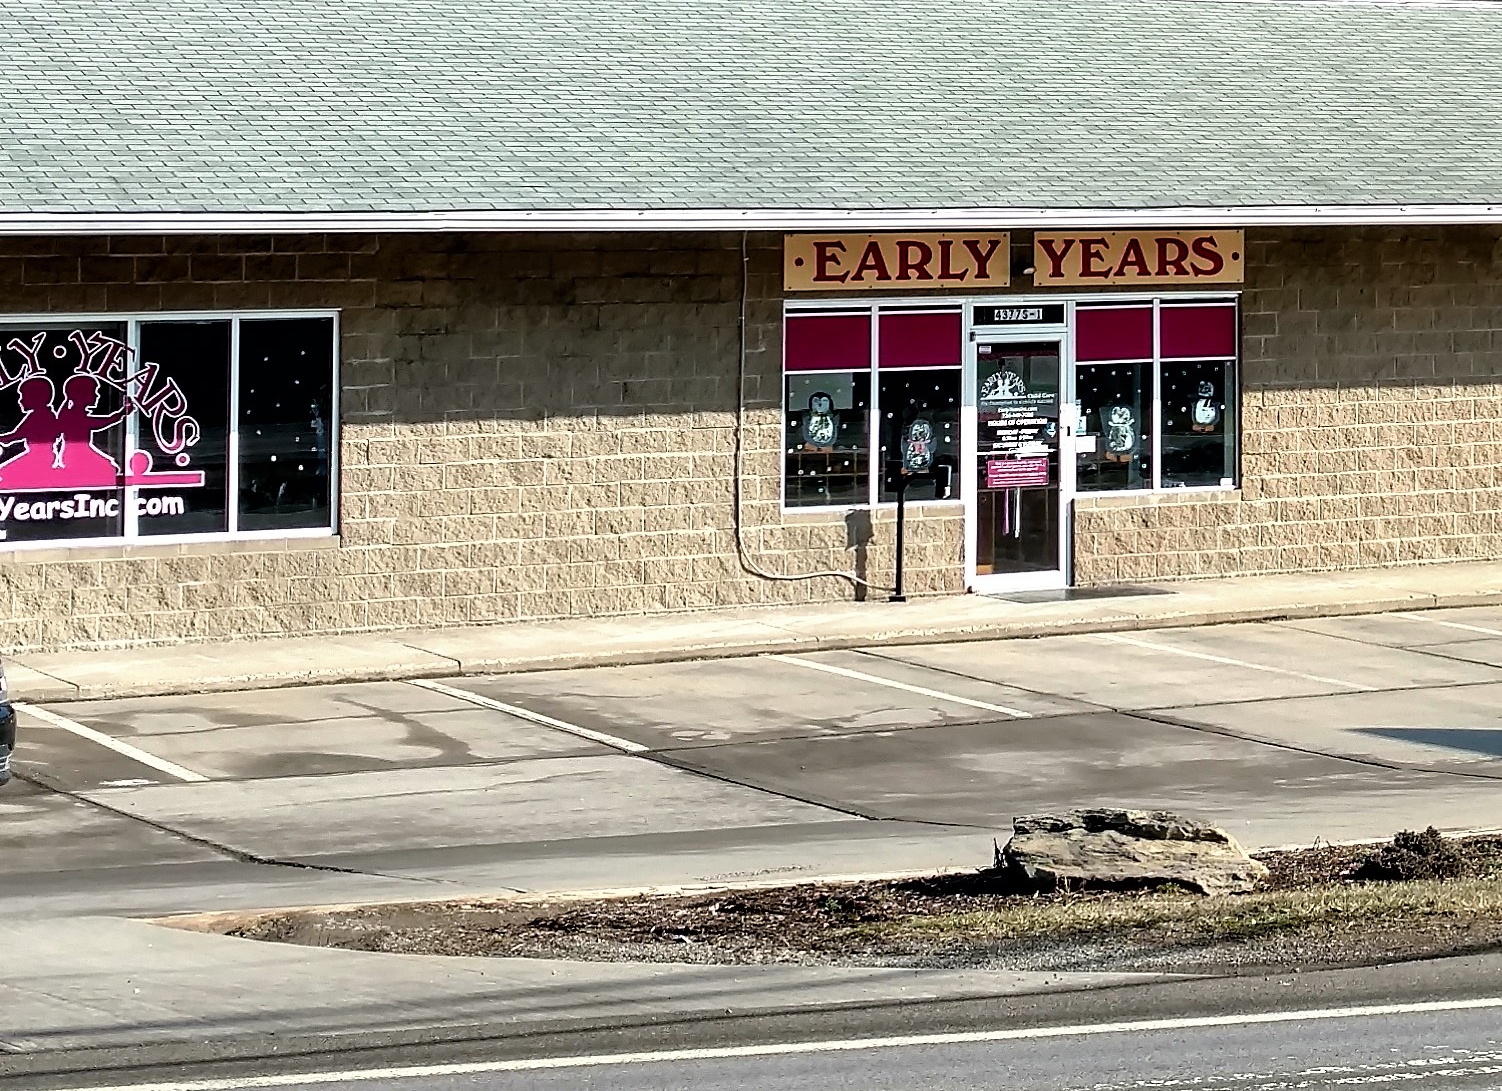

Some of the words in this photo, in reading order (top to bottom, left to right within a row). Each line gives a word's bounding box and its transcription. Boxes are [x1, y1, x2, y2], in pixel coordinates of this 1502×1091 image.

[812, 238, 1001, 284] EARLY
[1037, 235, 1225, 279] YEARS
[994, 309, 1041, 320] 43775-1
[68, 329, 200, 455] YEARS
